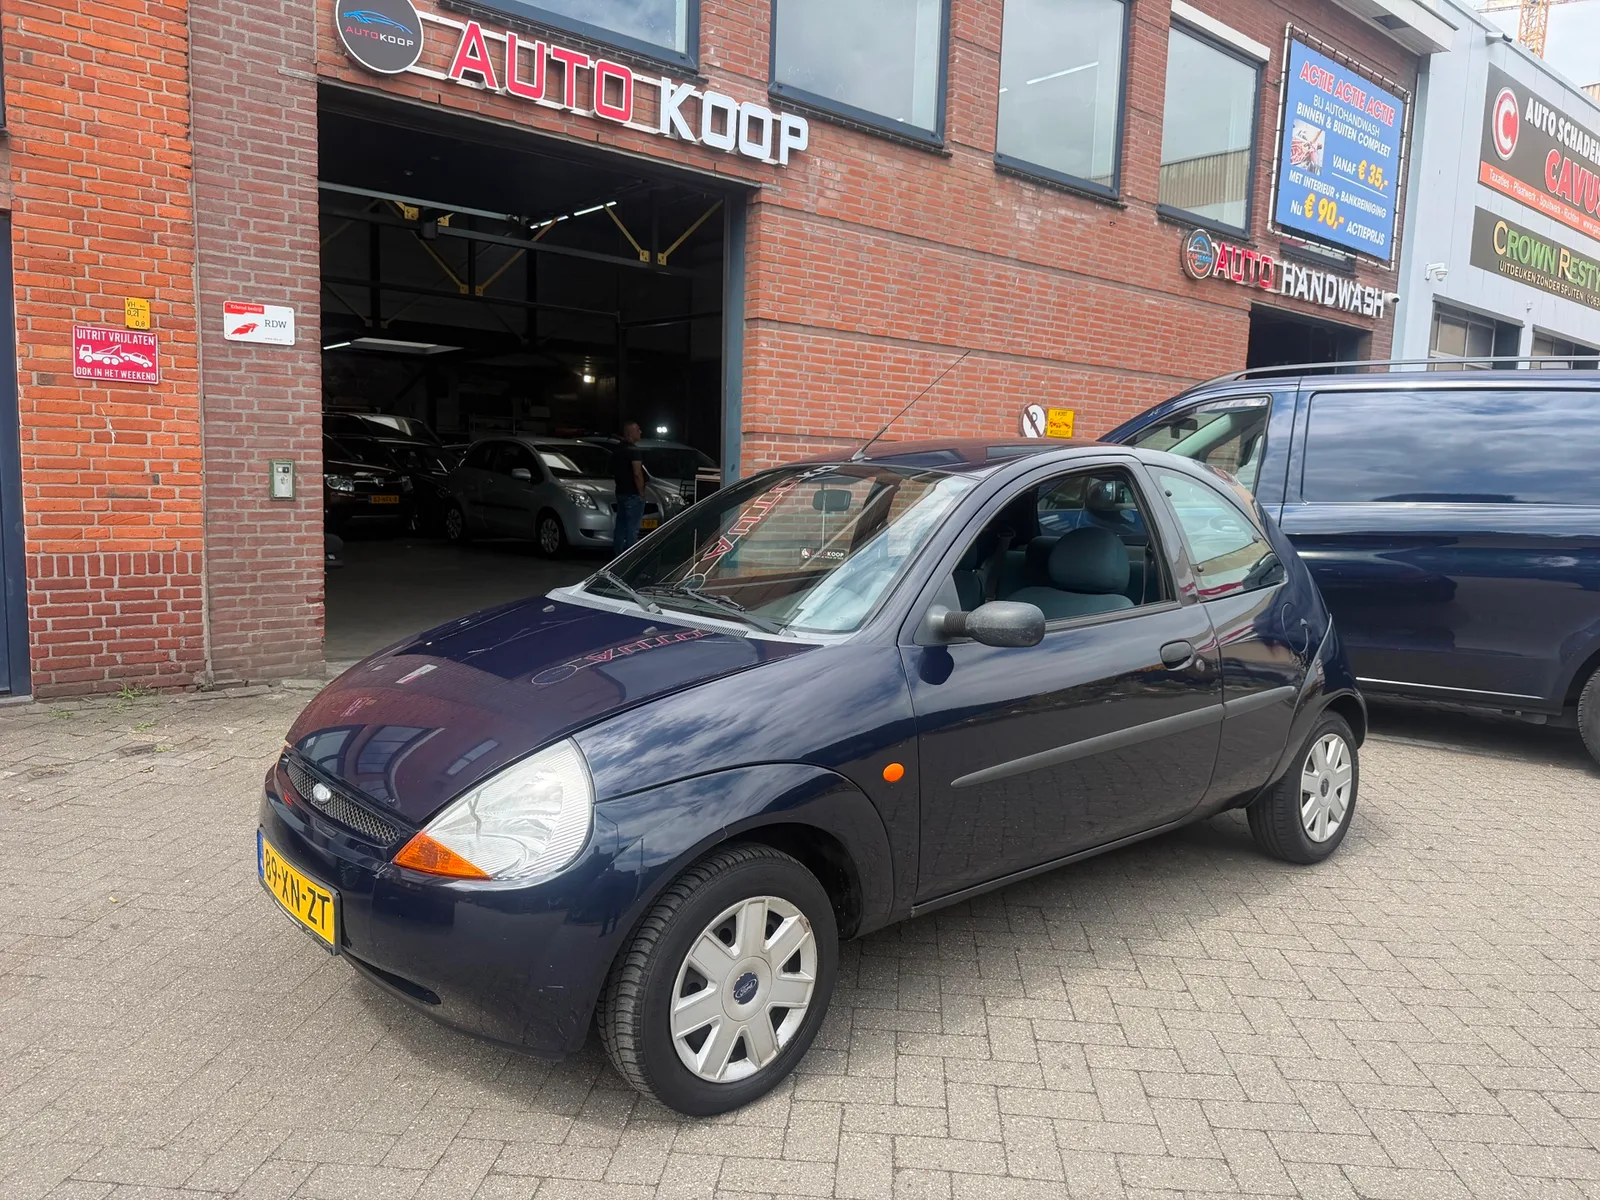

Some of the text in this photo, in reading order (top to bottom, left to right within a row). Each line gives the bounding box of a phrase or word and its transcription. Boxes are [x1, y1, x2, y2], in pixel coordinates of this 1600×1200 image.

[345, 26, 414, 47] AUTOKOOP
[448, 20, 809, 166] AUTO KOOP
[1299, 61, 1395, 127] ACTIE ACTIE ACTIE
[1313, 94, 1380, 138] BIJ AUTOHANDWASH
[1524, 97, 1557, 137] AUTO
[1296, 101, 1391, 158] BINNEN & BUITEN COMPLEET
[1332, 154, 1357, 175] VANAF
[1358, 159, 1367, 180] €
[1545, 148, 1600, 219] CAVU
[1288, 169, 1387, 219] MET INTERIEUR + BANKREINIGING
[1290, 200, 1303, 216] Nu
[1304, 192, 1316, 219] €
[1346, 221, 1386, 246] ACTIEPRIJS
[1493, 220, 1557, 275] CROWN
[1213, 241, 1386, 318] AUTO HANDWASH
[1499, 260, 1536, 284] UITDEUKEN
[1537, 274, 1560, 292] ZONDER
[1560, 284, 1584, 301] SPUITEN
[76, 328, 155, 346] UITRIT VRIJLATEN
[264, 319, 287, 329] RDW
[76, 366, 156, 381] OOK IN HET WEEKEND
[265, 848, 331, 930] 89-XN-ZT
